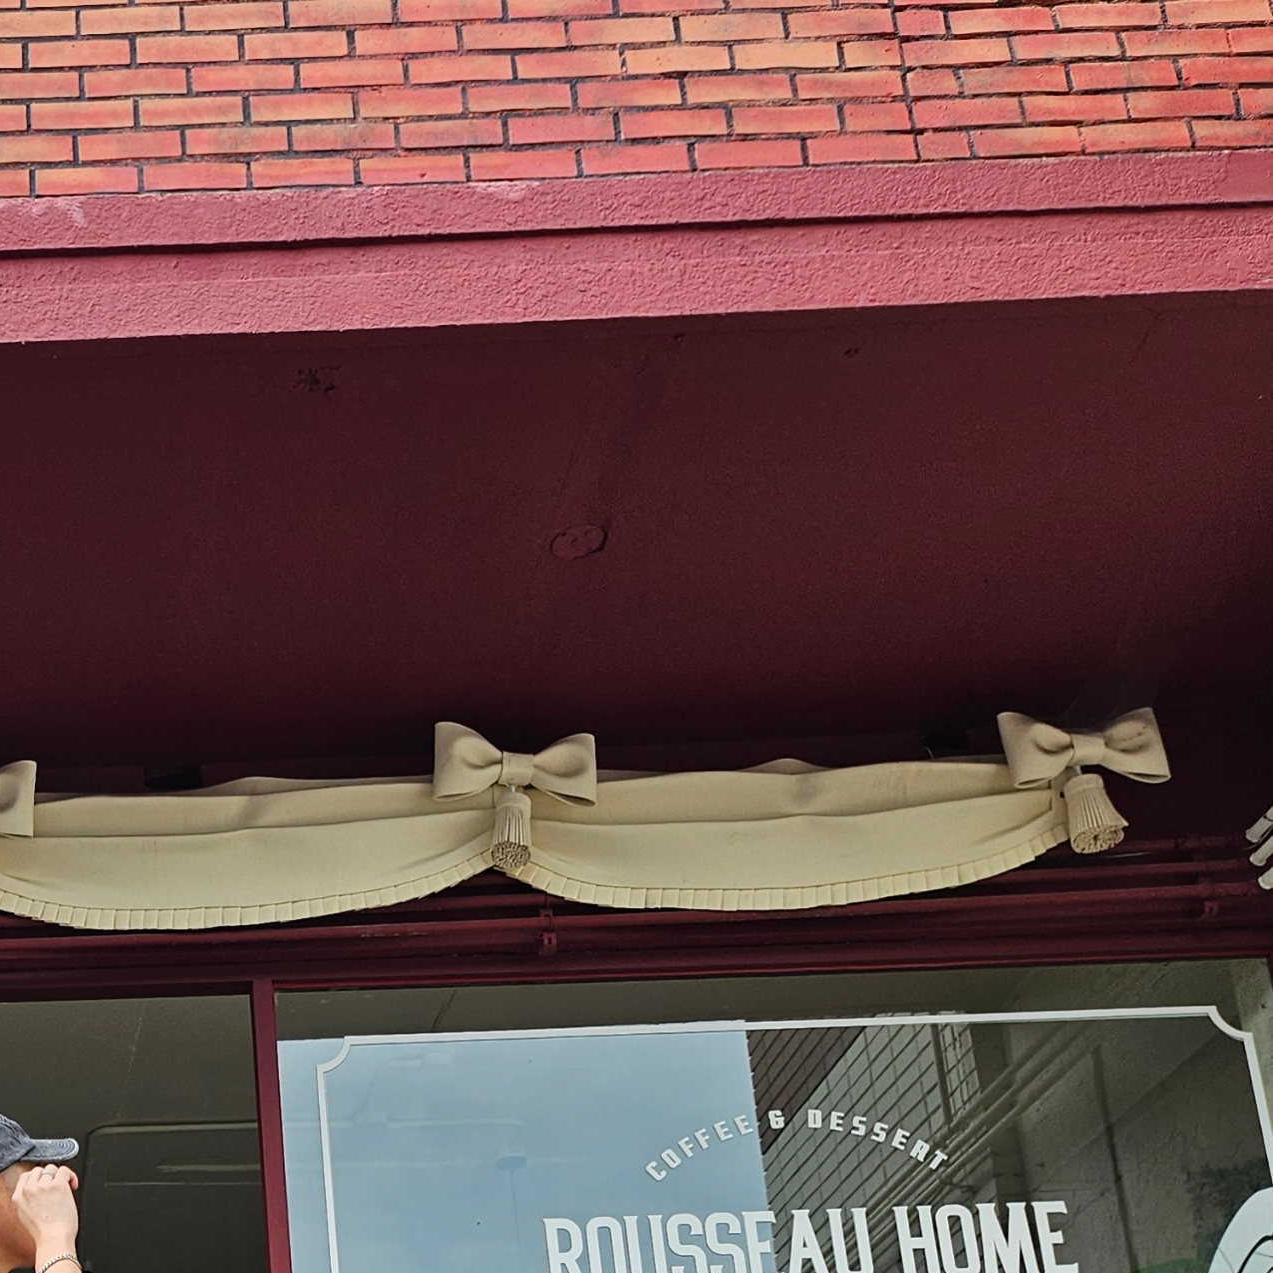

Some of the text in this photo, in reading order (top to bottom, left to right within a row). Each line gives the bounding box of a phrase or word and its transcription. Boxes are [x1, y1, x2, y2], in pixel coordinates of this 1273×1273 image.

[644, 1108, 949, 1182] COFFEE & DESSERT
